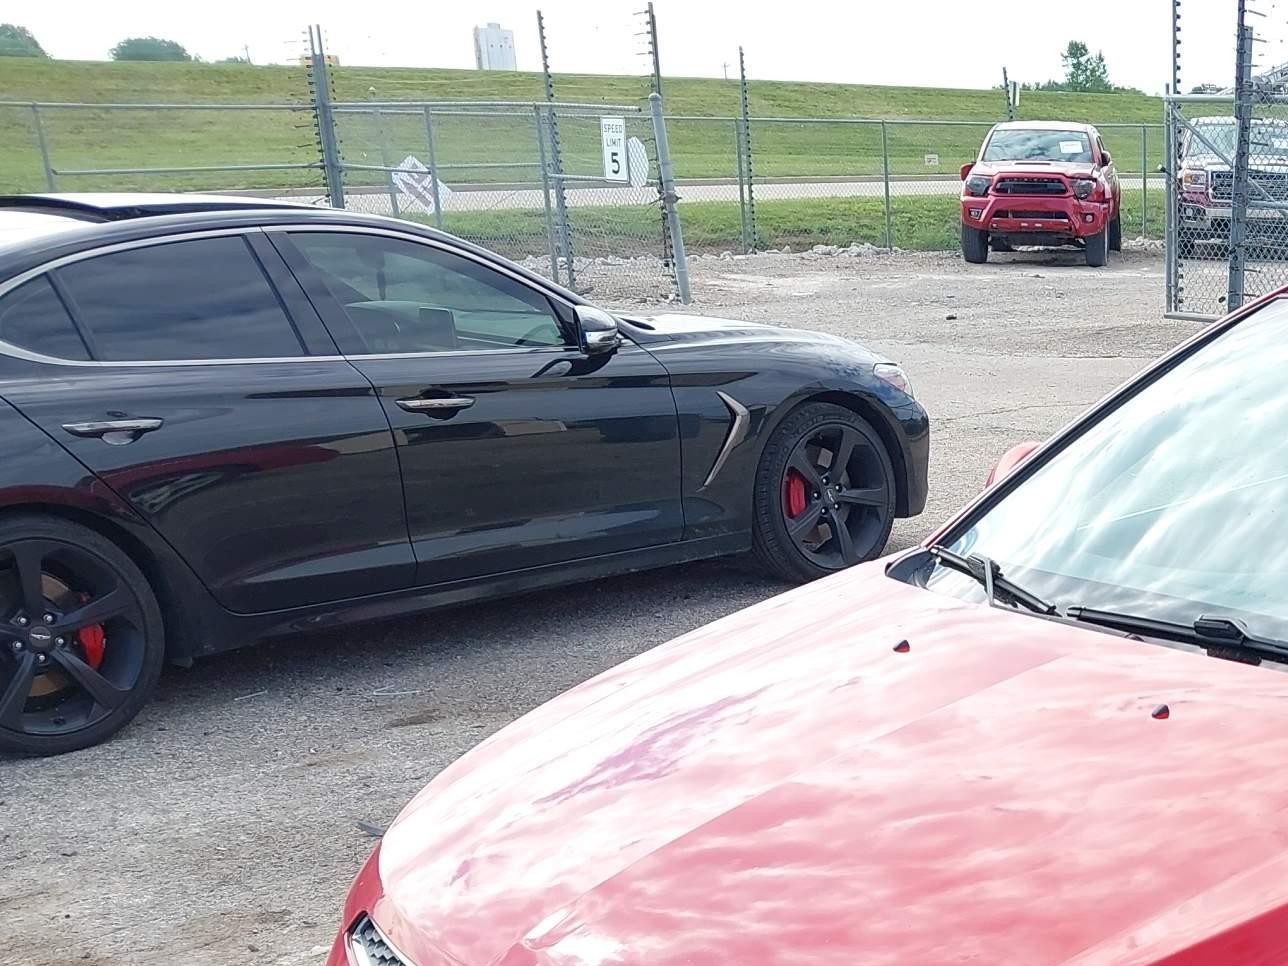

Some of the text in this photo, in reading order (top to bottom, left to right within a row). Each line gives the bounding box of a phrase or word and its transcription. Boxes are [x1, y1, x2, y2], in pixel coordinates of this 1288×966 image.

[603, 123, 623, 133] SPEED
[606, 137, 621, 147] LIMIT
[611, 152, 621, 174] 5
